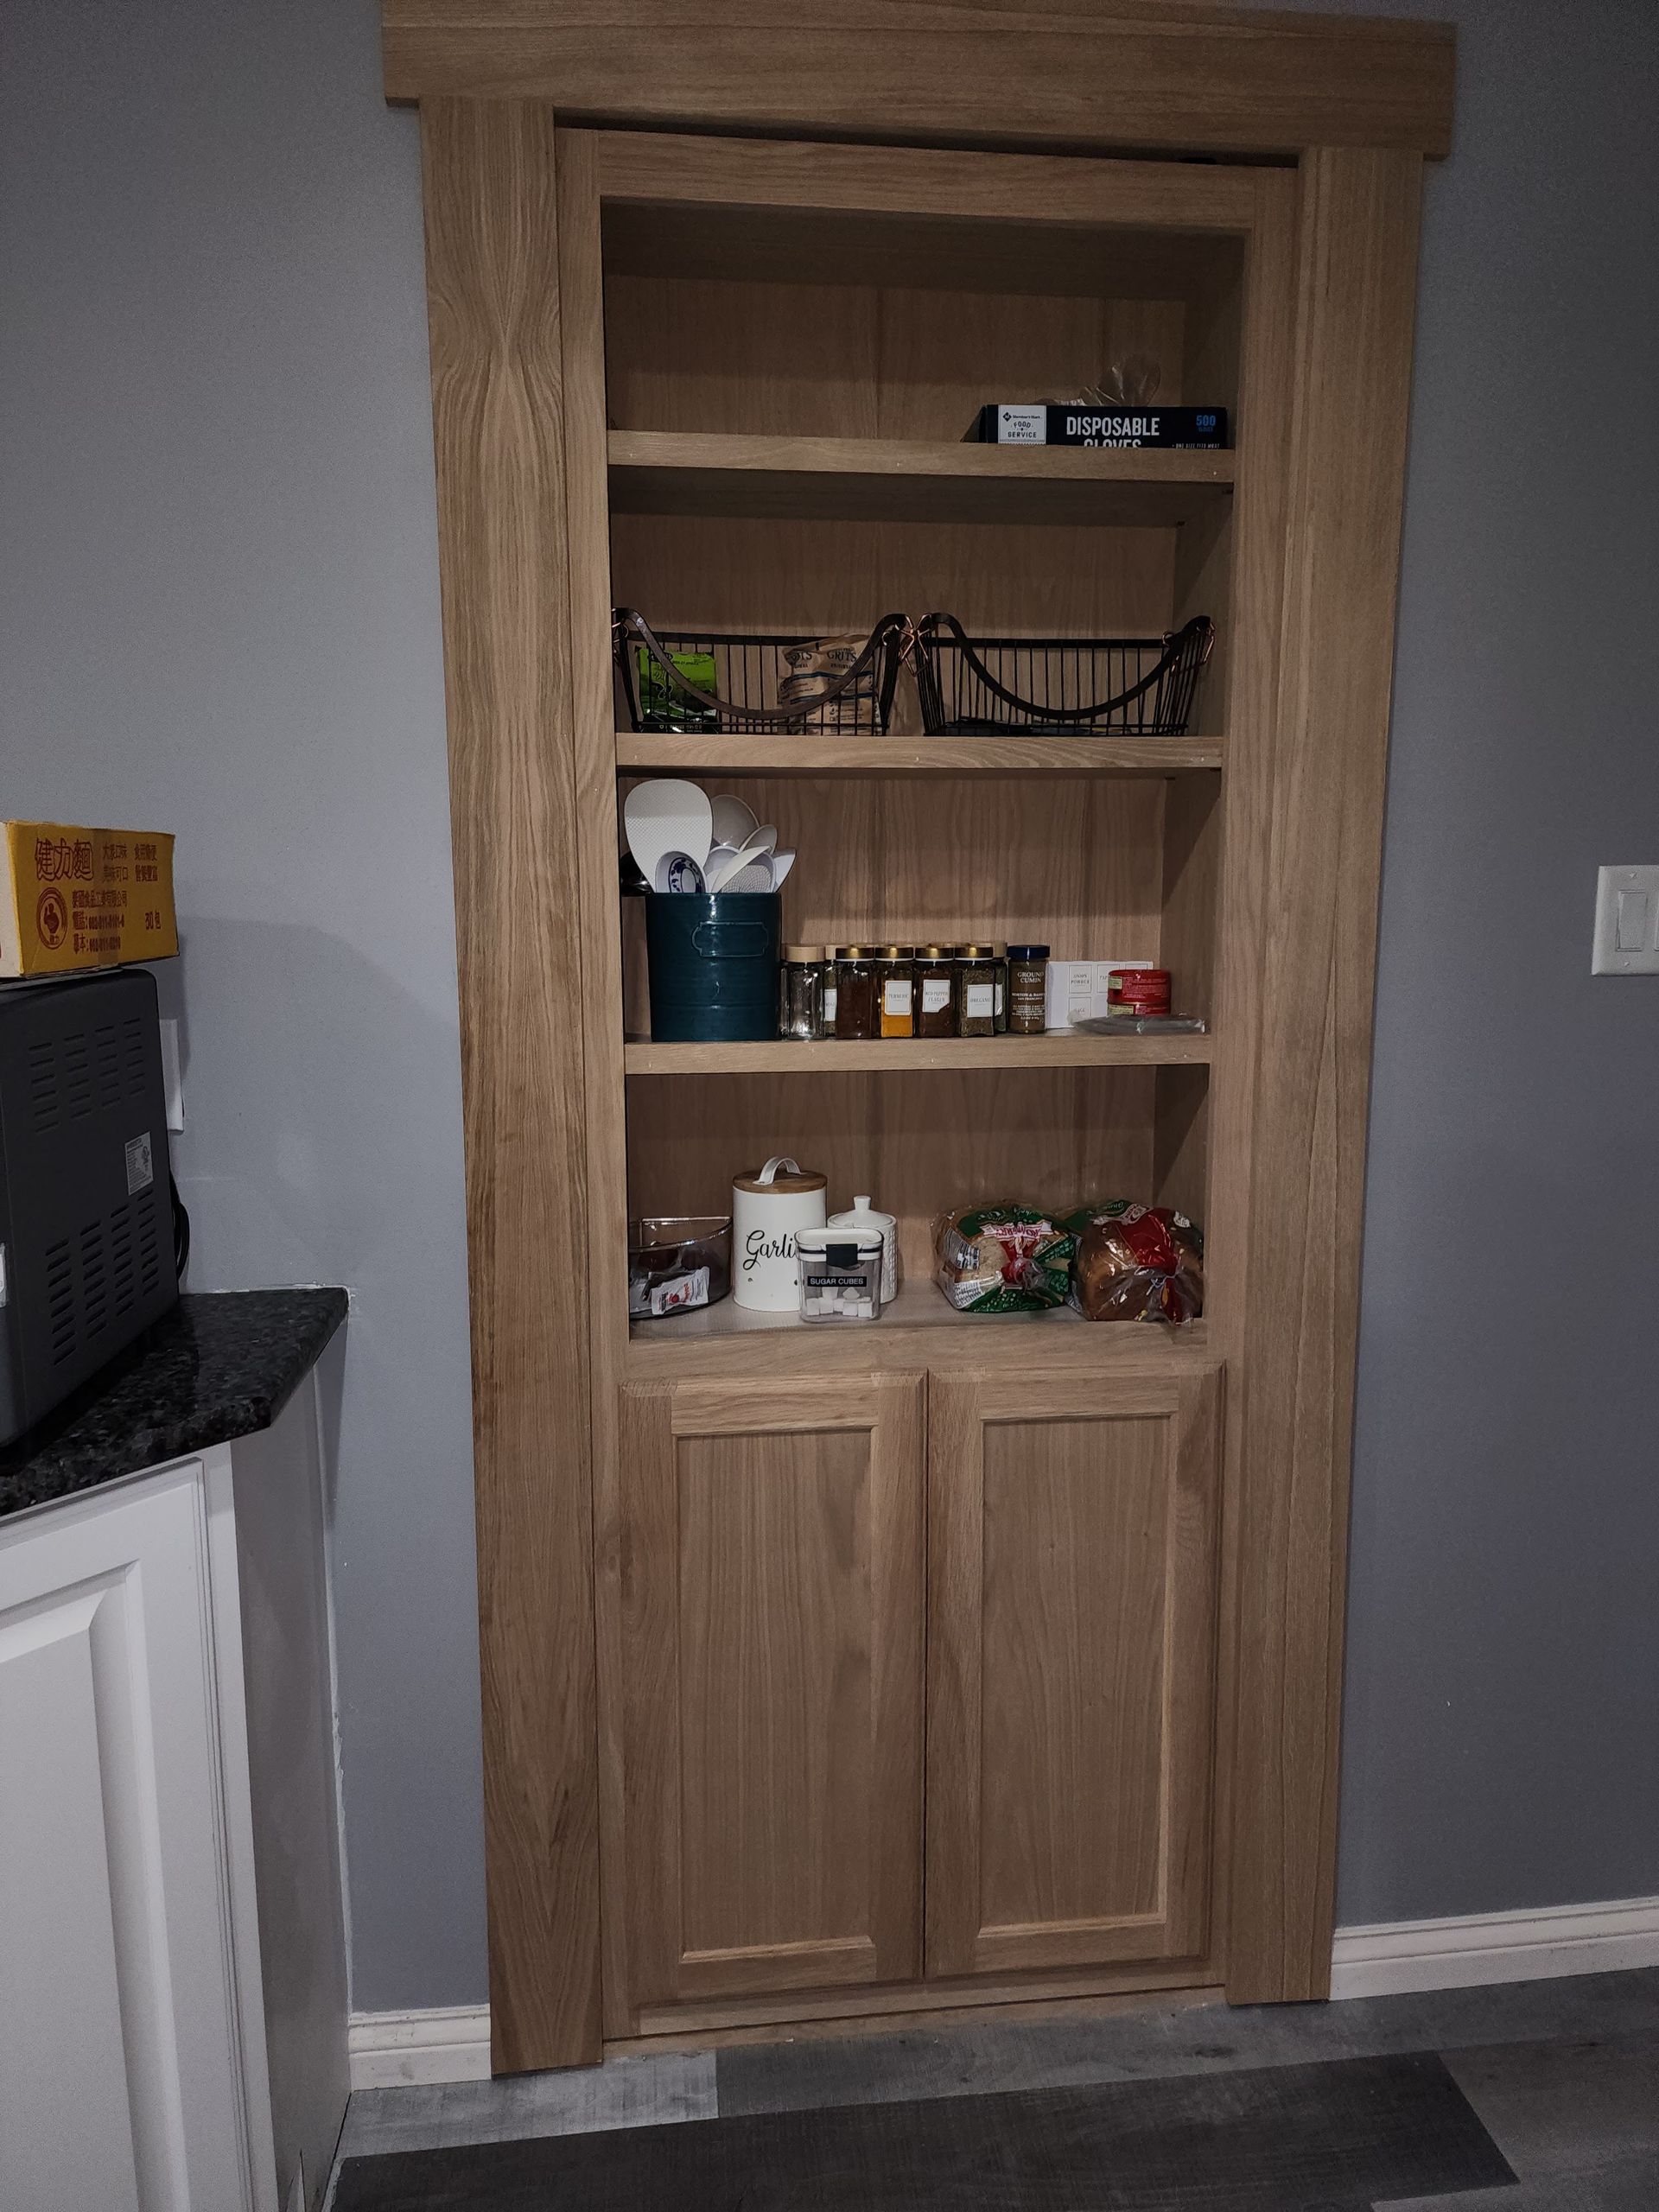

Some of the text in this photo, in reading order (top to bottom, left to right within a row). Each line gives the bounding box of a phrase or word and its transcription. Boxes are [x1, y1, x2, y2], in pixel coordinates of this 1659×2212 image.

[1066, 416, 1160, 435] DISPOSABLE
[1196, 415, 1216, 427] 500
[826, 649, 857, 663] GRITS
[742, 1230, 798, 1271] Garli
